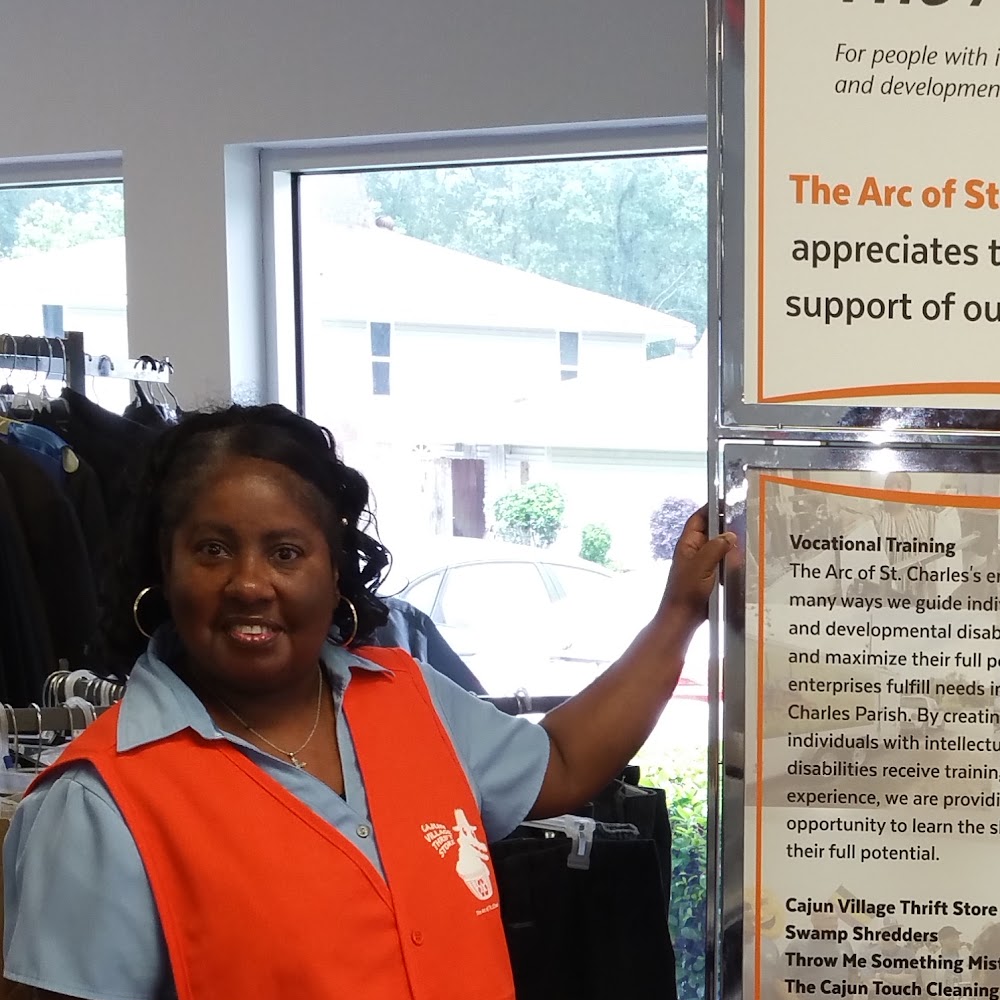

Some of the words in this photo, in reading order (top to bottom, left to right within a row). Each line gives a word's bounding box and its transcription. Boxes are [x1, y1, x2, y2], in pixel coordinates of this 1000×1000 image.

[836, 44, 866, 62] For
[871, 45, 937, 68] people
[946, 47, 987, 65] with
[835, 75, 874, 94] and
[790, 174, 851, 205] The
[858, 176, 912, 207] Arc
[922, 178, 957, 208] of
[792, 234, 978, 268] appreciates
[786, 294, 911, 325] support
[923, 292, 955, 320] of
[789, 534, 882, 552] Vocational
[885, 536, 956, 558] Training
[789, 562, 821, 579] The
[825, 563, 853, 580] Arc
[857, 564, 876, 580] of
[879, 565, 902, 581] St.
[906, 565, 982, 583] Charles's
[789, 595, 837, 611] many
[840, 596, 883, 613] ways
[887, 598, 911, 610] we
[915, 594, 962, 615] guide
[788, 620, 820, 636] and
[825, 621, 952, 641] developmental
[788, 648, 820, 664] and
[825, 649, 907, 666] maximize
[911, 651, 951, 667] their
[954, 651, 982, 668] full
[788, 677, 882, 696] enterprises
[886, 678, 930, 695] fulfill
[935, 680, 985, 696] needs
[788, 704, 850, 721] Charles
[855, 705, 912, 722] Parish.
[917, 707, 939, 726] By
[788, 732, 879, 750] individuals
[882, 734, 920, 750] with
[787, 760, 878, 777] disabilities
[882, 762, 940, 779] receive
[786, 788, 880, 808] experience,
[884, 794, 909, 806] we
[913, 794, 939, 806] are
[786, 816, 887, 836] opportunity
[889, 819, 908, 833] to
[912, 817, 953, 834] learn
[957, 819, 985, 835] the
[786, 842, 825, 859] their
[828, 843, 856, 859] full
[861, 845, 940, 863] potential.
[785, 897, 834, 916] Cajun
[837, 898, 896, 918] Village
[899, 899, 949, 916] Thrift
[952, 900, 998, 917] Store
[785, 924, 849, 944] Swamp
[852, 926, 939, 943] Shredders
[784, 952, 839, 968] Throw
[842, 953, 867, 969] Me
[871, 953, 964, 974] Something
[784, 978, 816, 994] The
[820, 979, 869, 998] Cajun
[872, 980, 922, 996] Touch
[926, 981, 1000, 1000] Cleaning
